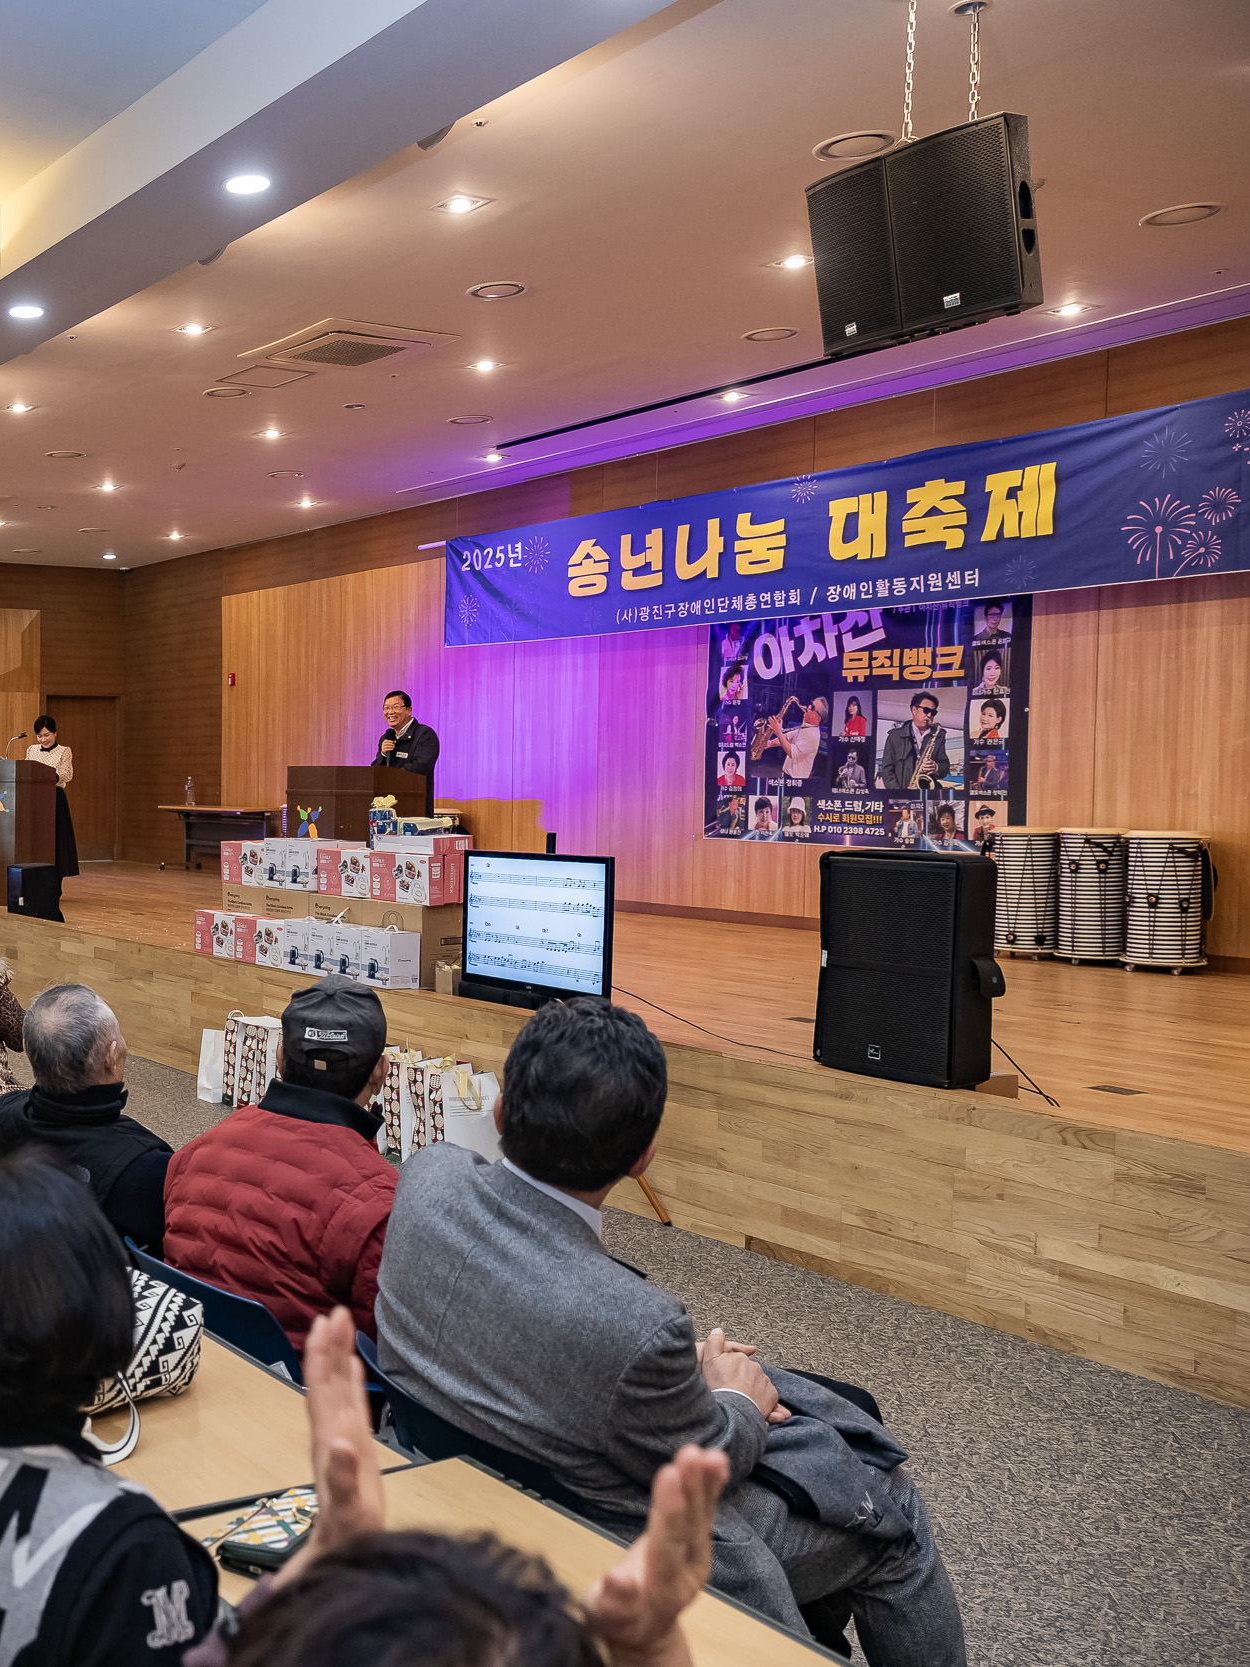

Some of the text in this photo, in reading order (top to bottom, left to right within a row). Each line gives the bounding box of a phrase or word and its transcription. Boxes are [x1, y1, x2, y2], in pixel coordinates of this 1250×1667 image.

[567, 462, 1057, 598] 송년나눔 대축제
[461, 541, 523, 573] 2025년
[616, 568, 980, 625] (사)광진구장애인단체총연합회 / 장애인활동지원센터
[753, 608, 886, 680] 아차산
[842, 645, 965, 683] 뮤직뱅크
[973, 738, 985, 746] 가수
[768, 779, 784, 788] 색소폰
[816, 799, 884, 813] 색소폰,드럼,기타
[817, 812, 883, 825] 수시로 회원모집!!!
[813, 825, 885, 836] H.P 010 2398 4725
